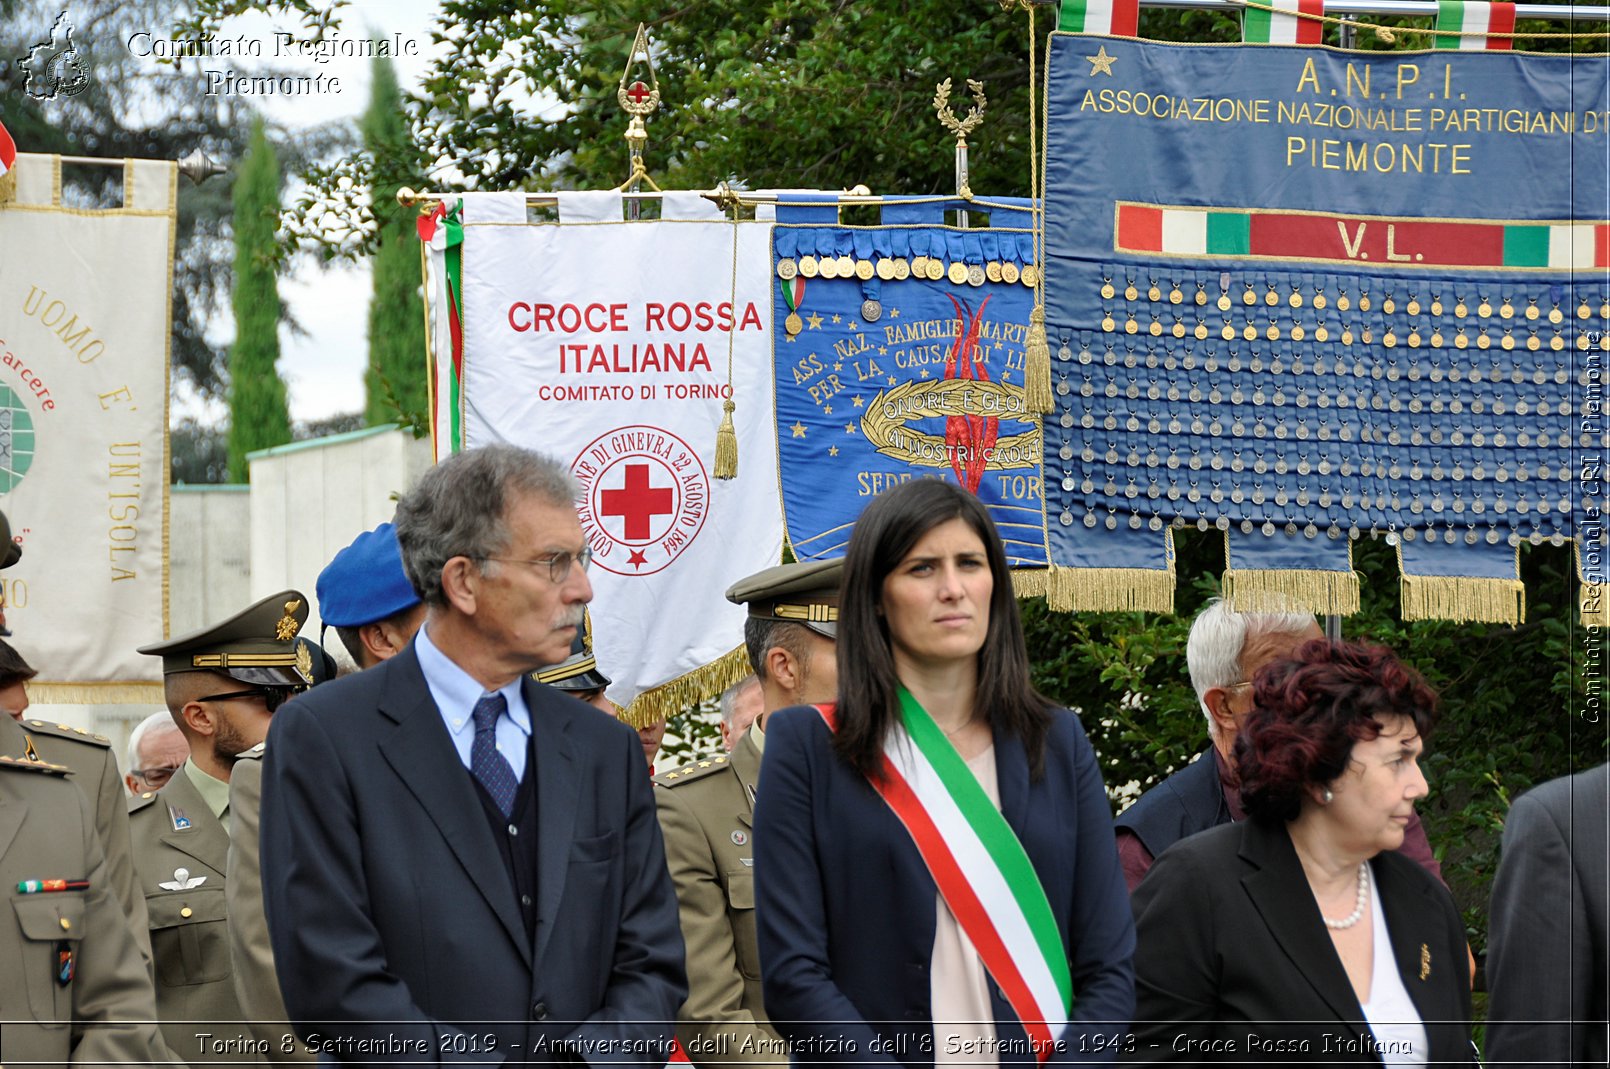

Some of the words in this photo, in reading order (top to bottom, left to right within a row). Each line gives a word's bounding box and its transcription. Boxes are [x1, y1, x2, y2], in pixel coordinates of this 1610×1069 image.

[1080, 89, 1270, 124] ASSOCIAZIONE
[1278, 102, 1423, 133] NAZIONALE
[1429, 107, 1575, 134] PARTIGIANI
[1285, 136, 1472, 175] PIEMONTE
[507, 301, 629, 333] CROCE
[645, 301, 763, 332] ROSSA
[559, 343, 713, 374] ITALIANA
[792, 352, 829, 386] ASS.
[833, 333, 875, 361] NAZ.
[884, 318, 964, 346] FAMIGLIE
[807, 374, 847, 406] PER
[853, 358, 885, 382] LA
[895, 344, 956, 369] CAUSA
[972, 344, 992, 363] DI
[1005, 349, 1027, 370] LI
[538, 385, 634, 401] COMITATO
[640, 385, 657, 400] DI
[663, 383, 734, 400] TORINO
[882, 392, 951, 420] ONORE
[963, 390, 975, 411] E
[22, 284, 105, 364] UOMO
[108, 441, 141, 583] UN'ISOLA
[611, 431, 675, 460] GINEVRA
[888, 428, 904, 450] AI
[909, 439, 975, 463] NOSTRI
[590, 443, 612, 466] DI
[671, 451, 692, 473] 22
[680, 473, 704, 528] AGOSTO
[661, 527, 689, 557] 1864
